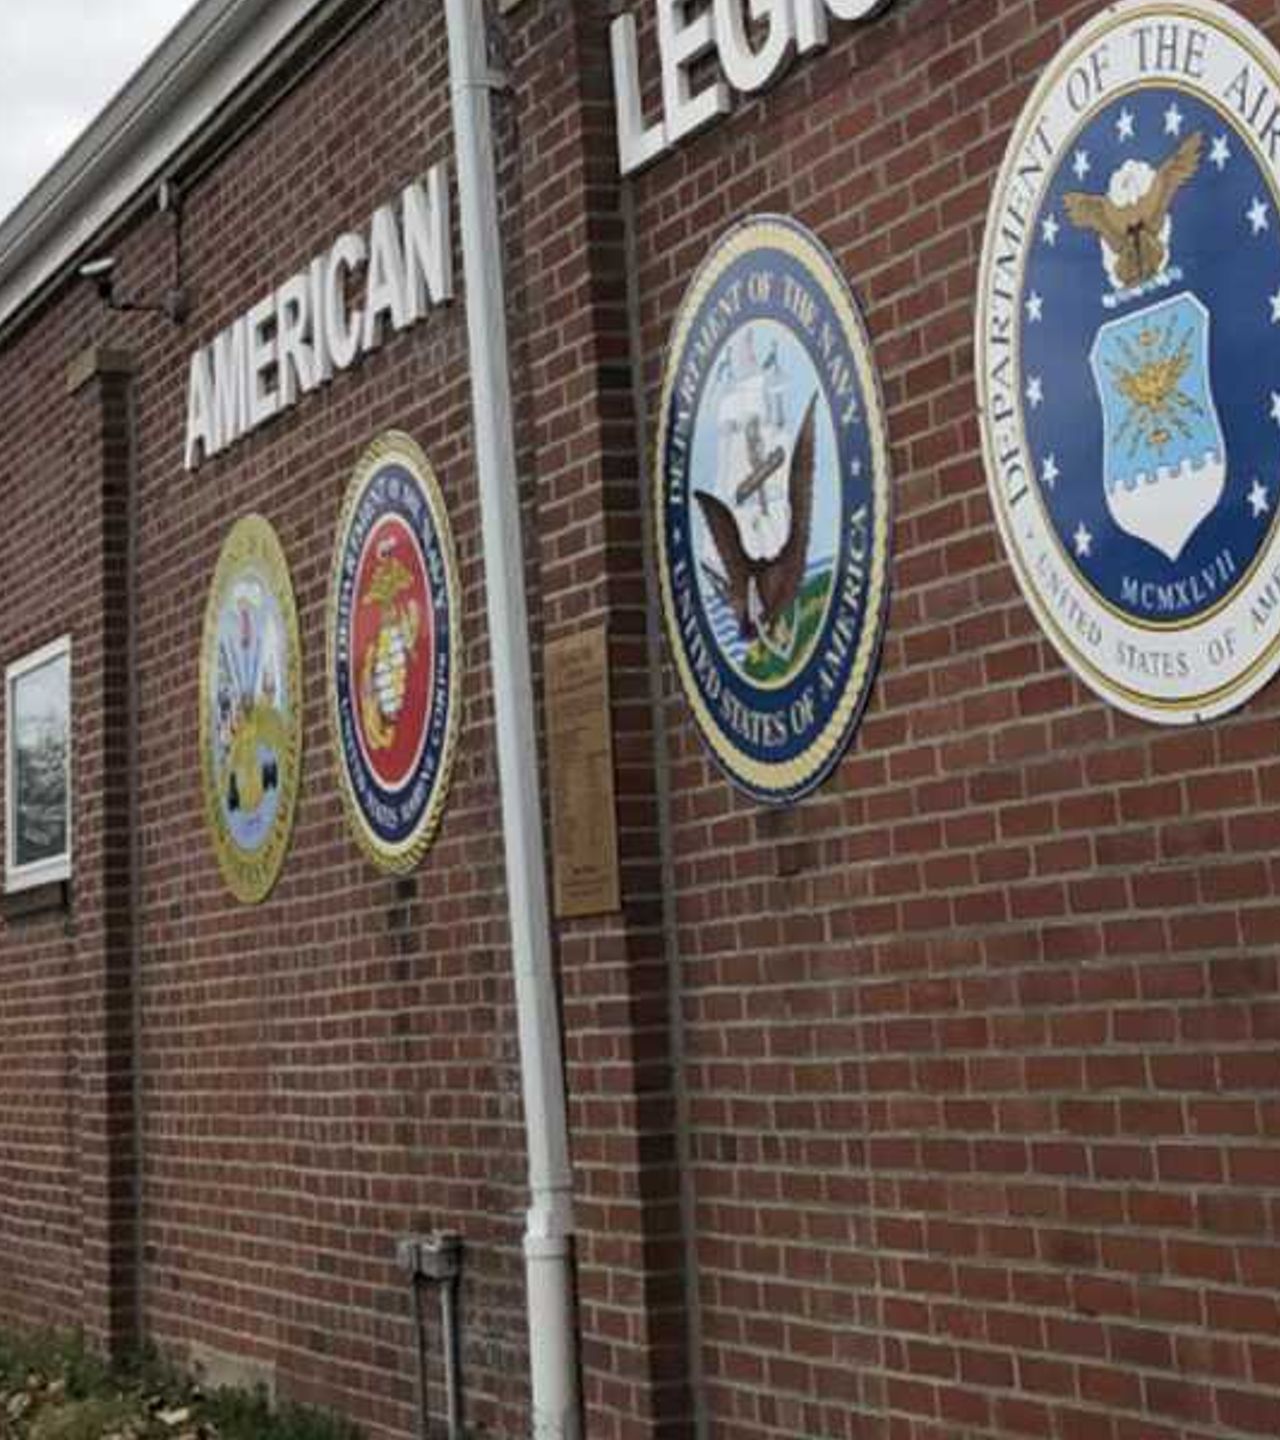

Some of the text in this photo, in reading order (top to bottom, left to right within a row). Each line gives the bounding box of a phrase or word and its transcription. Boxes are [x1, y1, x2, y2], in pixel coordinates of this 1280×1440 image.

[184, 162, 453, 472] AMERICAN
[991, 114, 1053, 506] DEPARTMENT
[1066, 44, 1110, 112] OF
[1132, 23, 1208, 78] THE
[722, 686, 788, 747] STATES
[791, 686, 815, 734] OF
[819, 507, 867, 702] AMERICA
[1037, 550, 1102, 647] UNITED
[1118, 644, 1191, 678] STATES
[1206, 628, 1238, 665] OF
[1120, 548, 1236, 611] MCMXLVII
